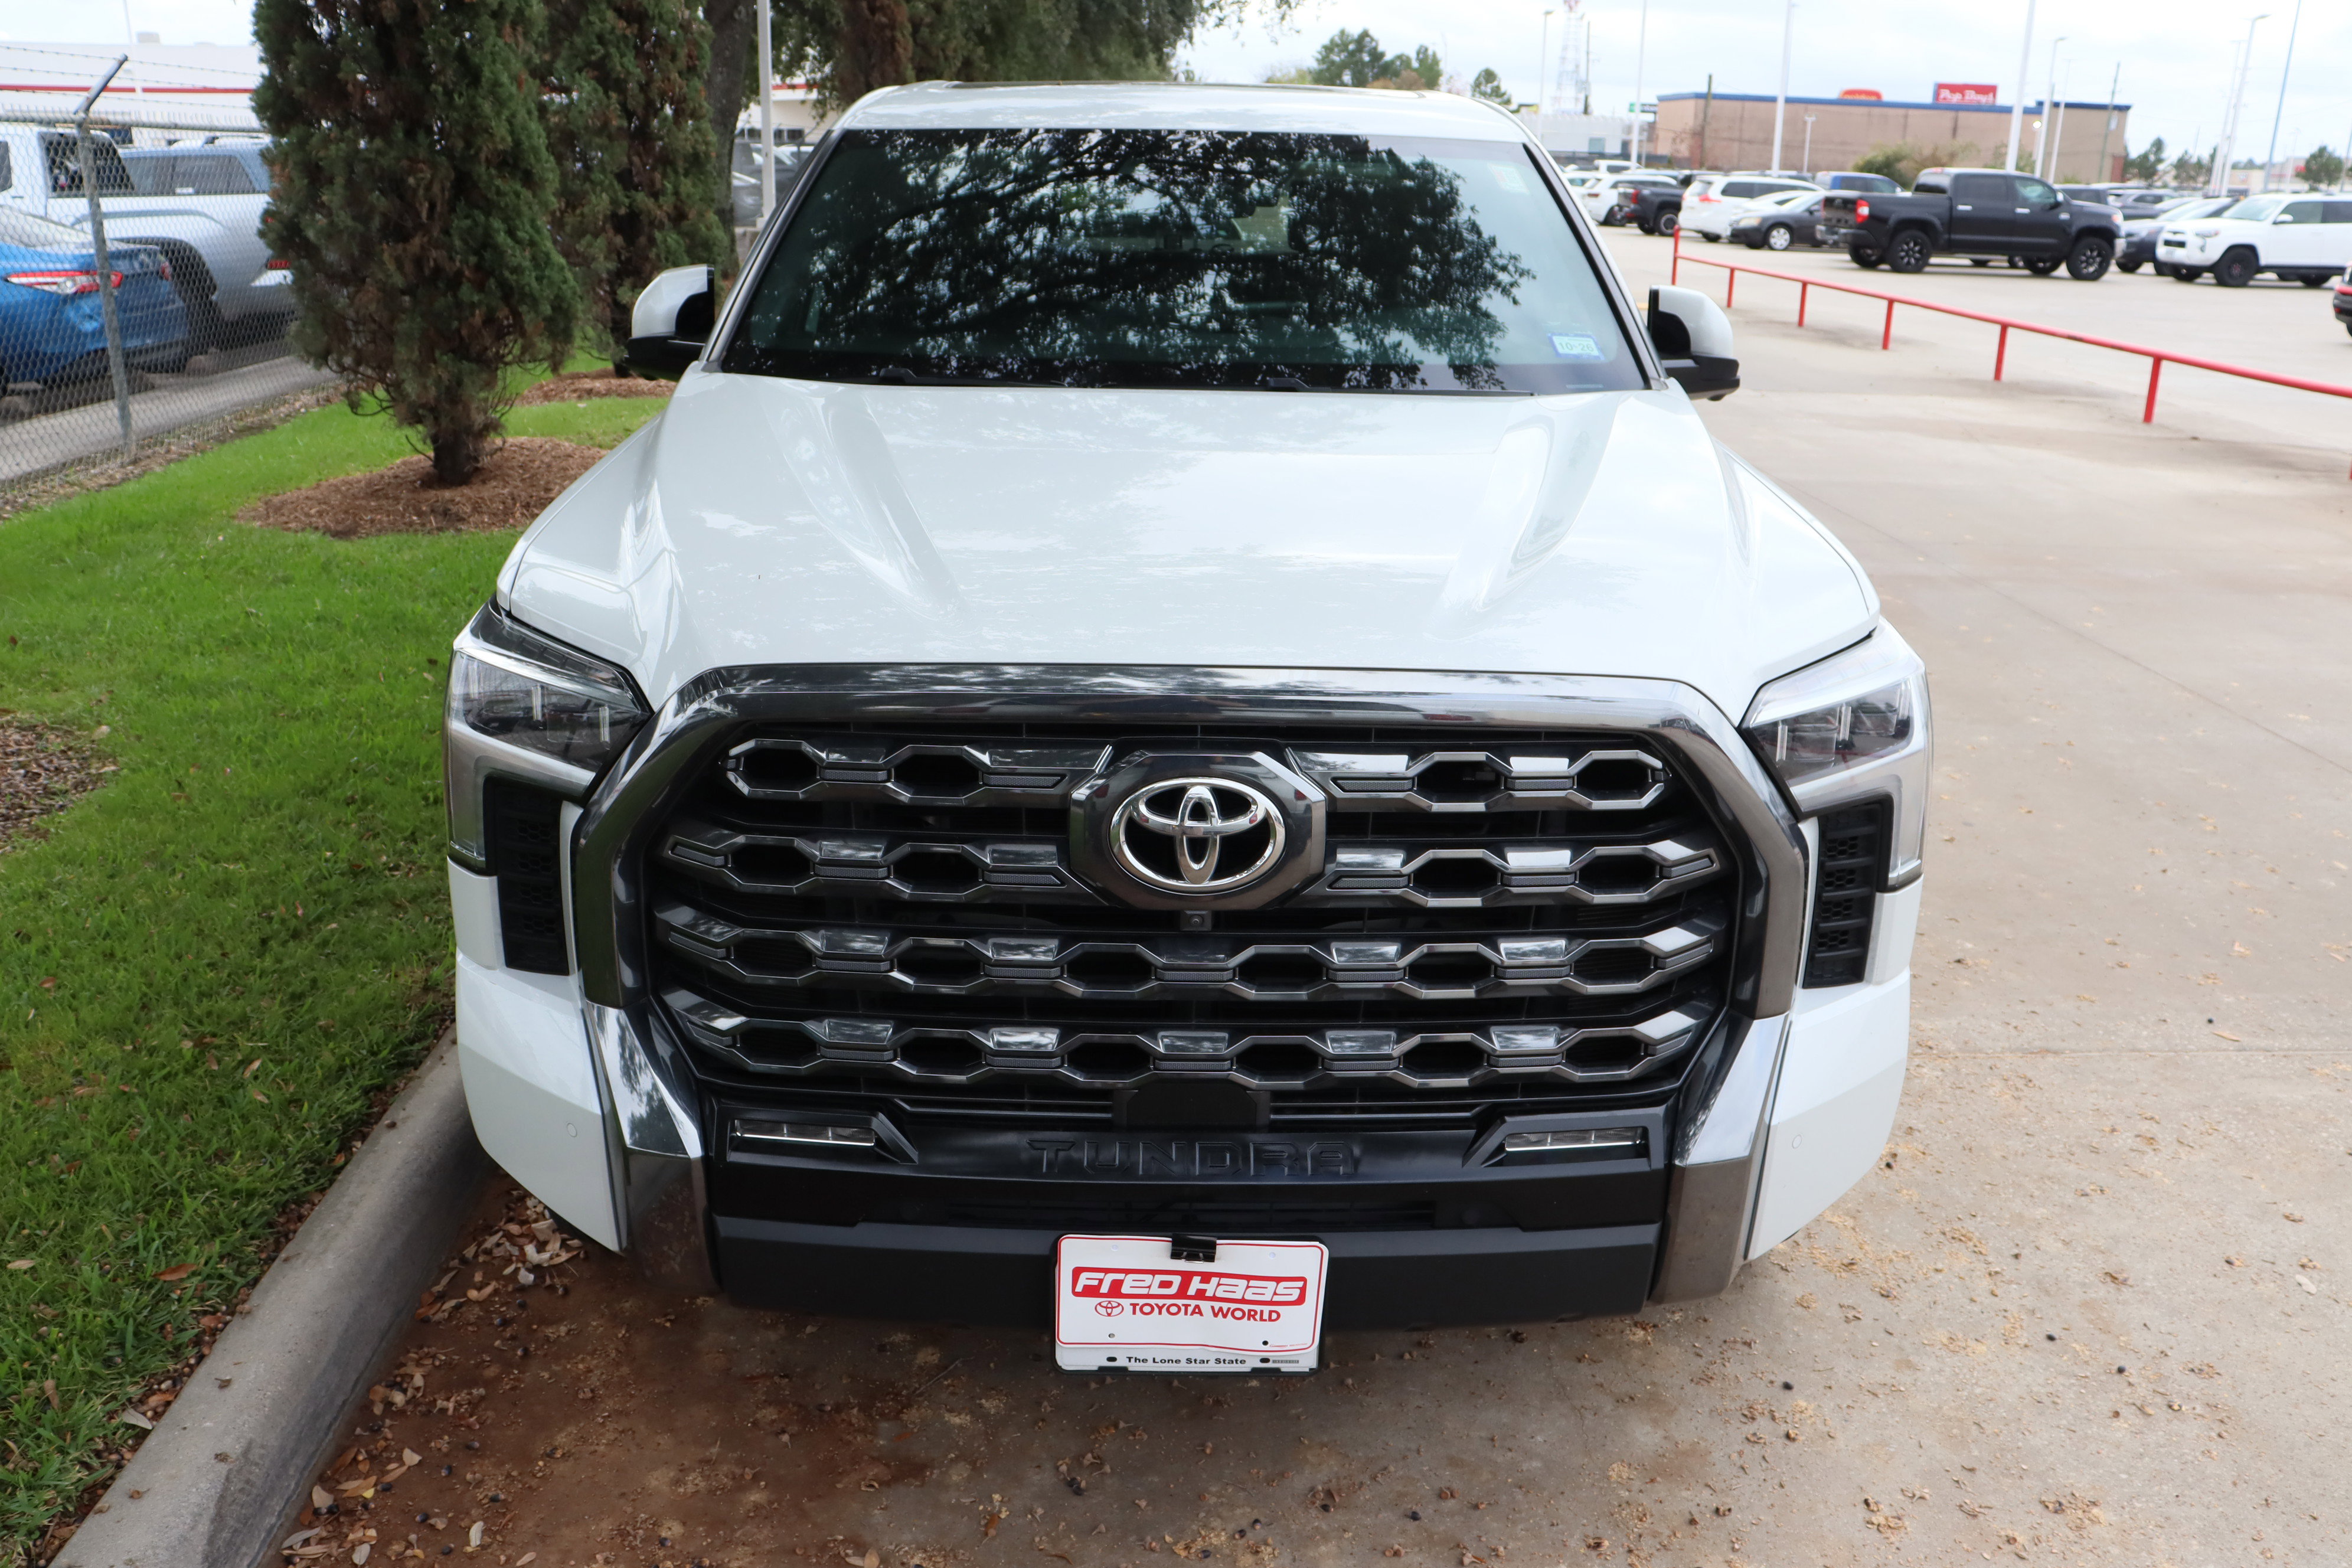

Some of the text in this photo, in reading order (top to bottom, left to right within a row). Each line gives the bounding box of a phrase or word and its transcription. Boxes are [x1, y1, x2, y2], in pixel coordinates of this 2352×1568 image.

[1026, 1139, 1355, 1176] TUNDRA
[1129, 1302, 1281, 1322] TOYOTA WORLD
